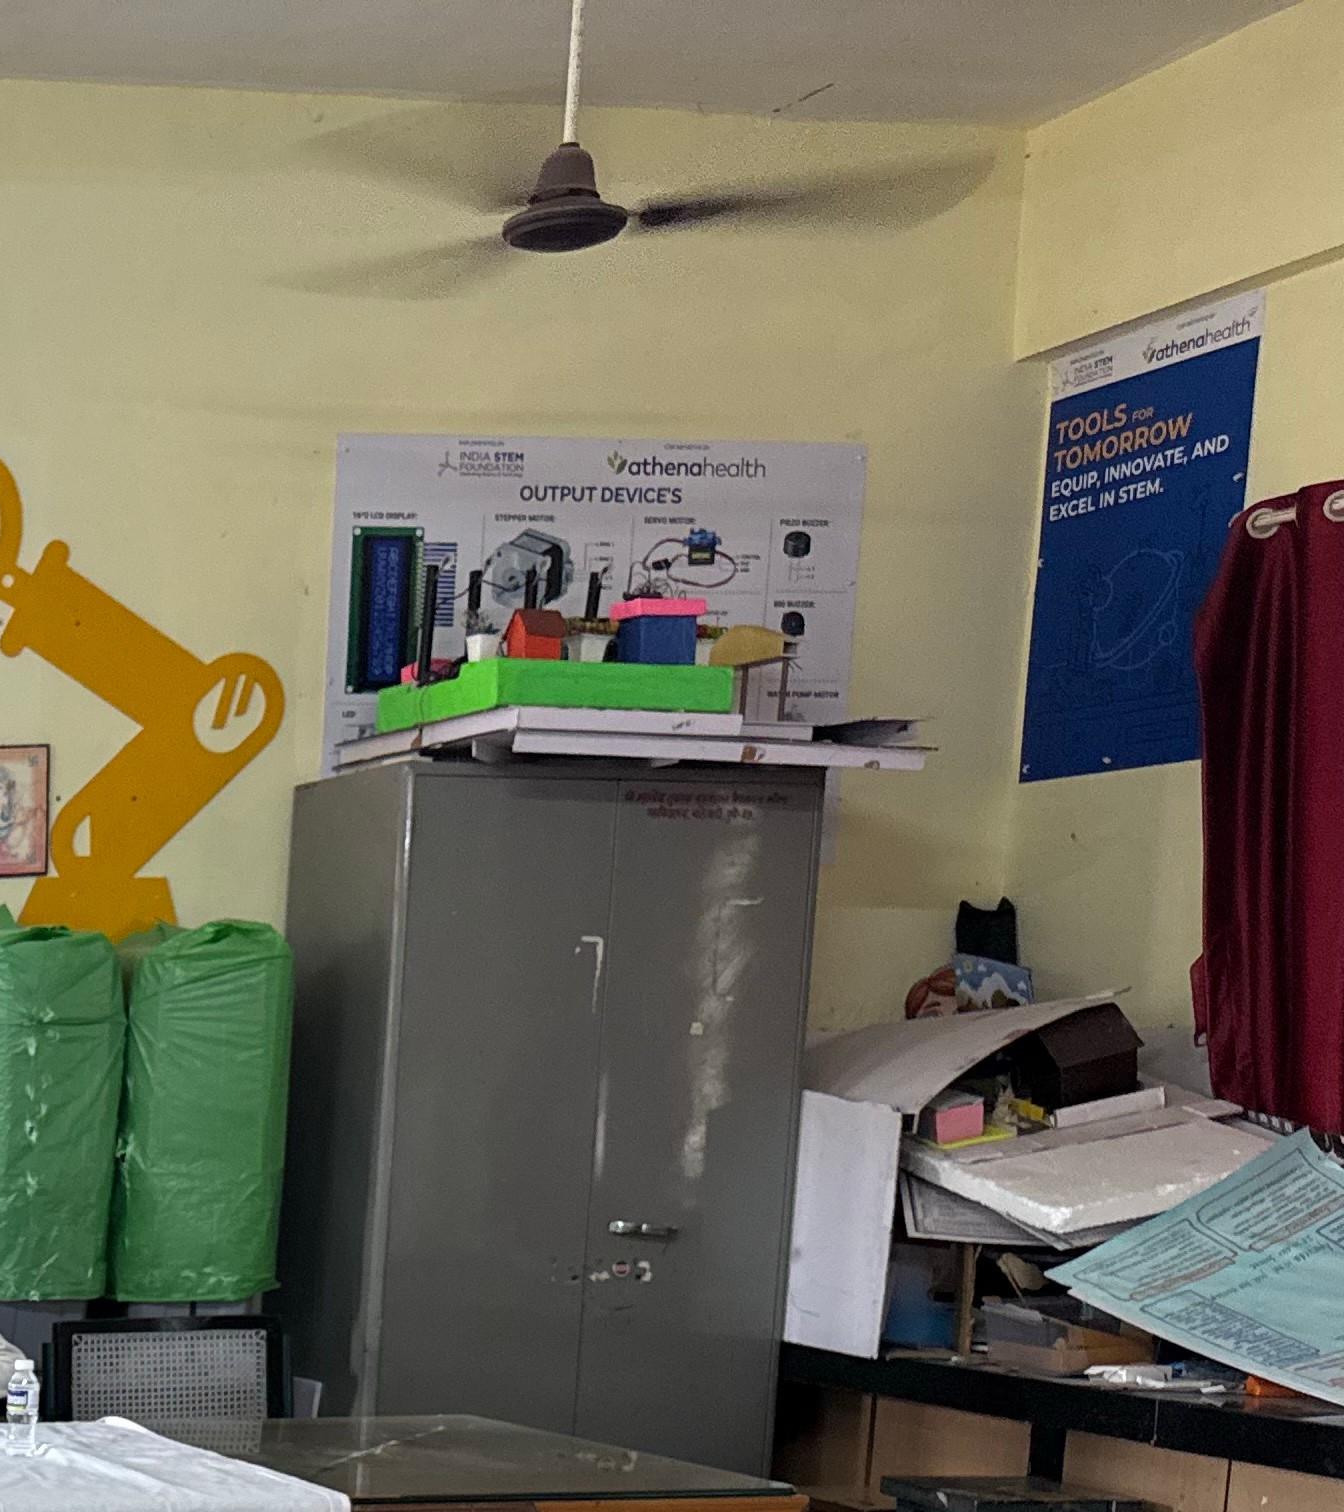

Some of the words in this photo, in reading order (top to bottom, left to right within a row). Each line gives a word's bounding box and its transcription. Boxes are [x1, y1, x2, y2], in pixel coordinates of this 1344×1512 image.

[1155, 316, 1251, 362] athenahealth
[1054, 412, 1193, 472] TOMORROW
[1056, 403, 1127, 444] TOOLS
[1132, 407, 1154, 422] FOR
[459, 451, 490, 462] INDIA
[494, 452, 524, 463] STEM
[459, 462, 524, 472] FOUNDATION
[628, 456, 766, 478] athenahealth
[1051, 474, 1100, 498] EQUIP,
[1105, 445, 1188, 484] INNOVATE,
[1191, 435, 1229, 460] AND
[520, 485, 597, 503] OUTPUT
[601, 487, 682, 504] DEVICE'S
[1049, 498, 1096, 522] EXCEL
[1099, 489, 1115, 509] IN
[1118, 478, 1164, 504] STEM.
